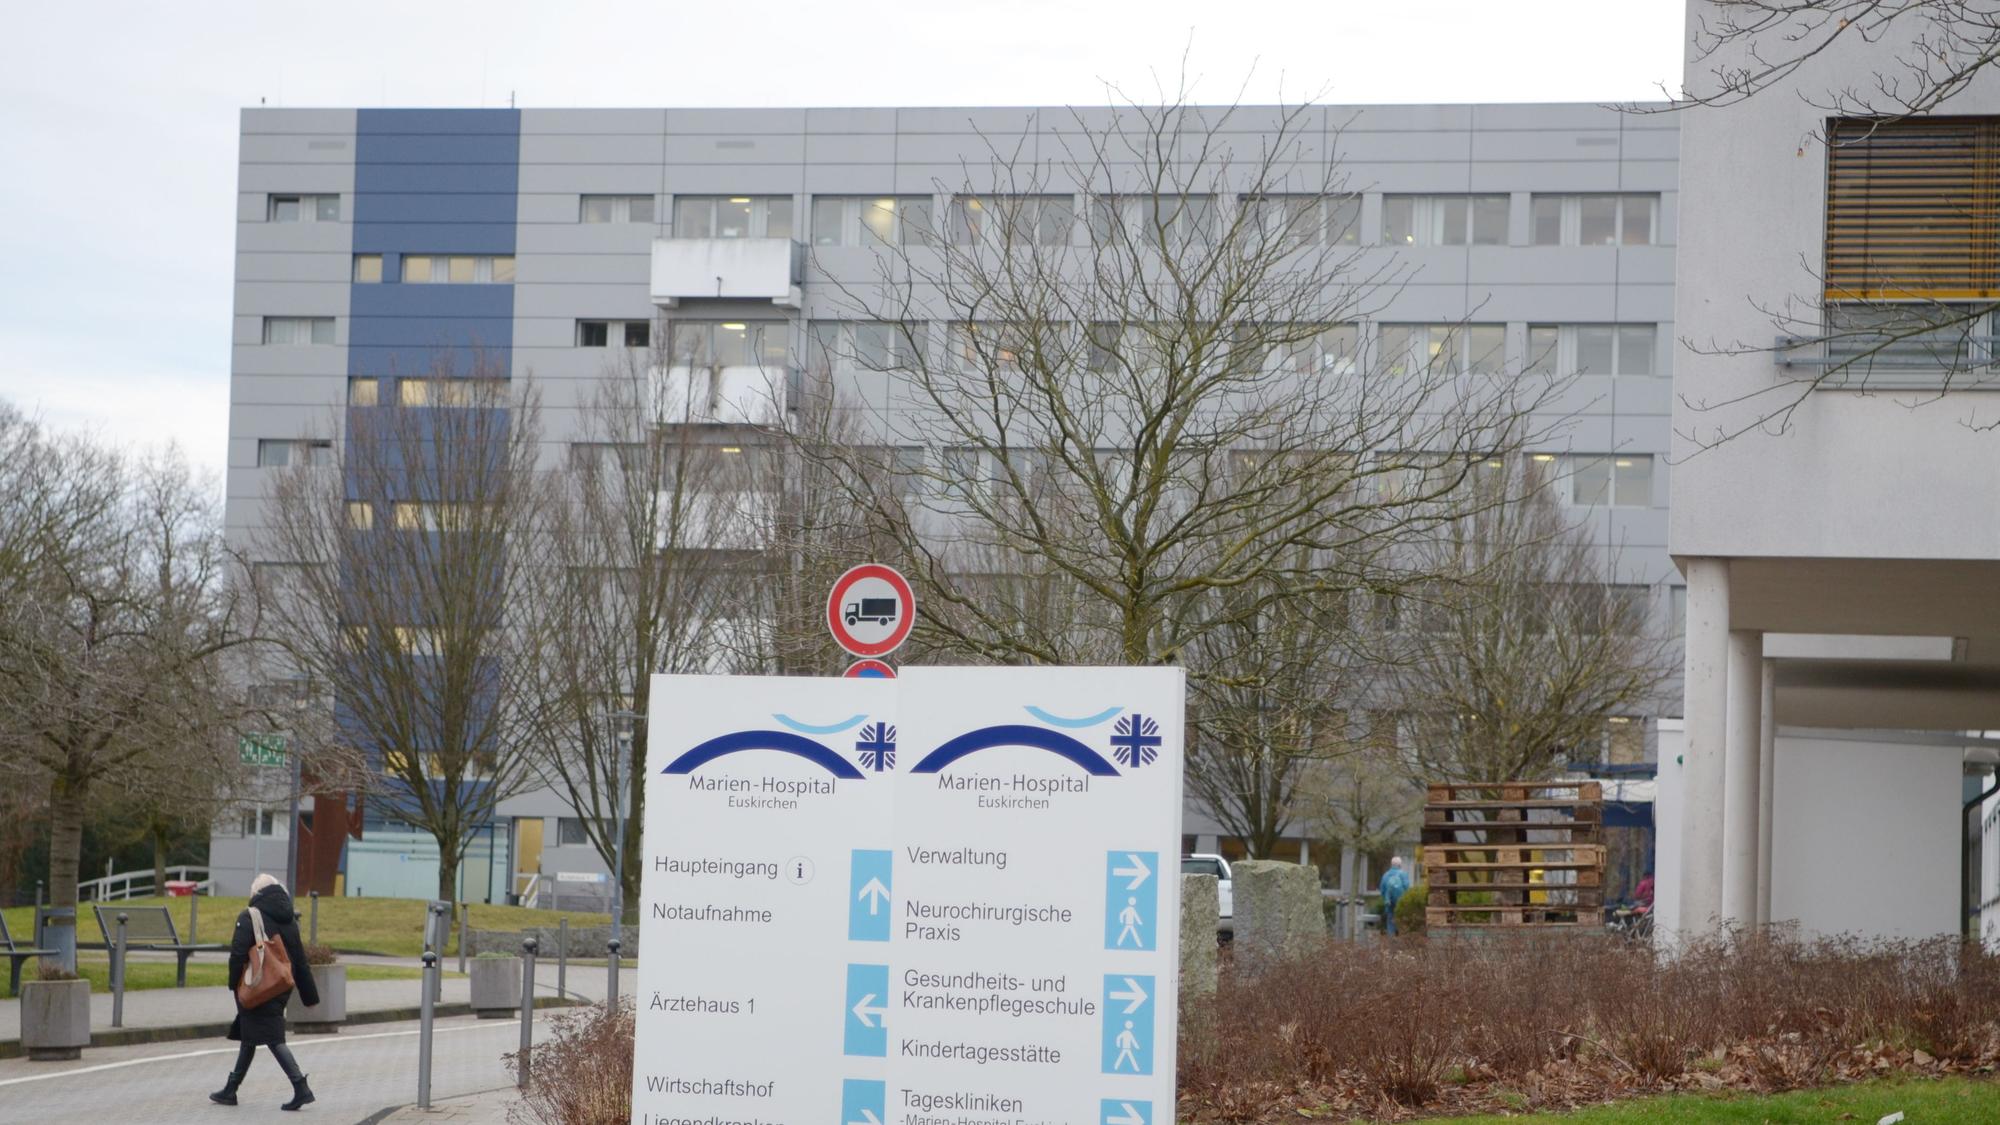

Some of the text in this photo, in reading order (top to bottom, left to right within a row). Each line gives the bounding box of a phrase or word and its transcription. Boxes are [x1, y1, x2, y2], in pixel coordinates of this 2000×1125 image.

[689, 775, 836, 796] Marien-Hospital
[938, 773, 1090, 796] Marien-Hospital
[728, 795, 798, 809] Euskirchen
[978, 795, 1050, 809] Euskirchen
[655, 856, 778, 879] Haupteingang
[907, 847, 1007, 869] Verwaltung
[653, 903, 772, 923] Notaufnahme
[906, 900, 1072, 925] Neurochirurgische
[905, 922, 961, 941] Praxis
[904, 969, 1066, 992] Gesundheits- und
[650, 992, 755, 1014] Ärztehaus 1
[903, 991, 1096, 1017] Krankenpflegeschule
[901, 1039, 1061, 1064] Kindertagesstätte
[646, 1076, 775, 1097] Wirtschaftshof
[900, 1089, 1023, 1112] Tageskliniken
[644, 1113, 785, 1125] Liegendk
